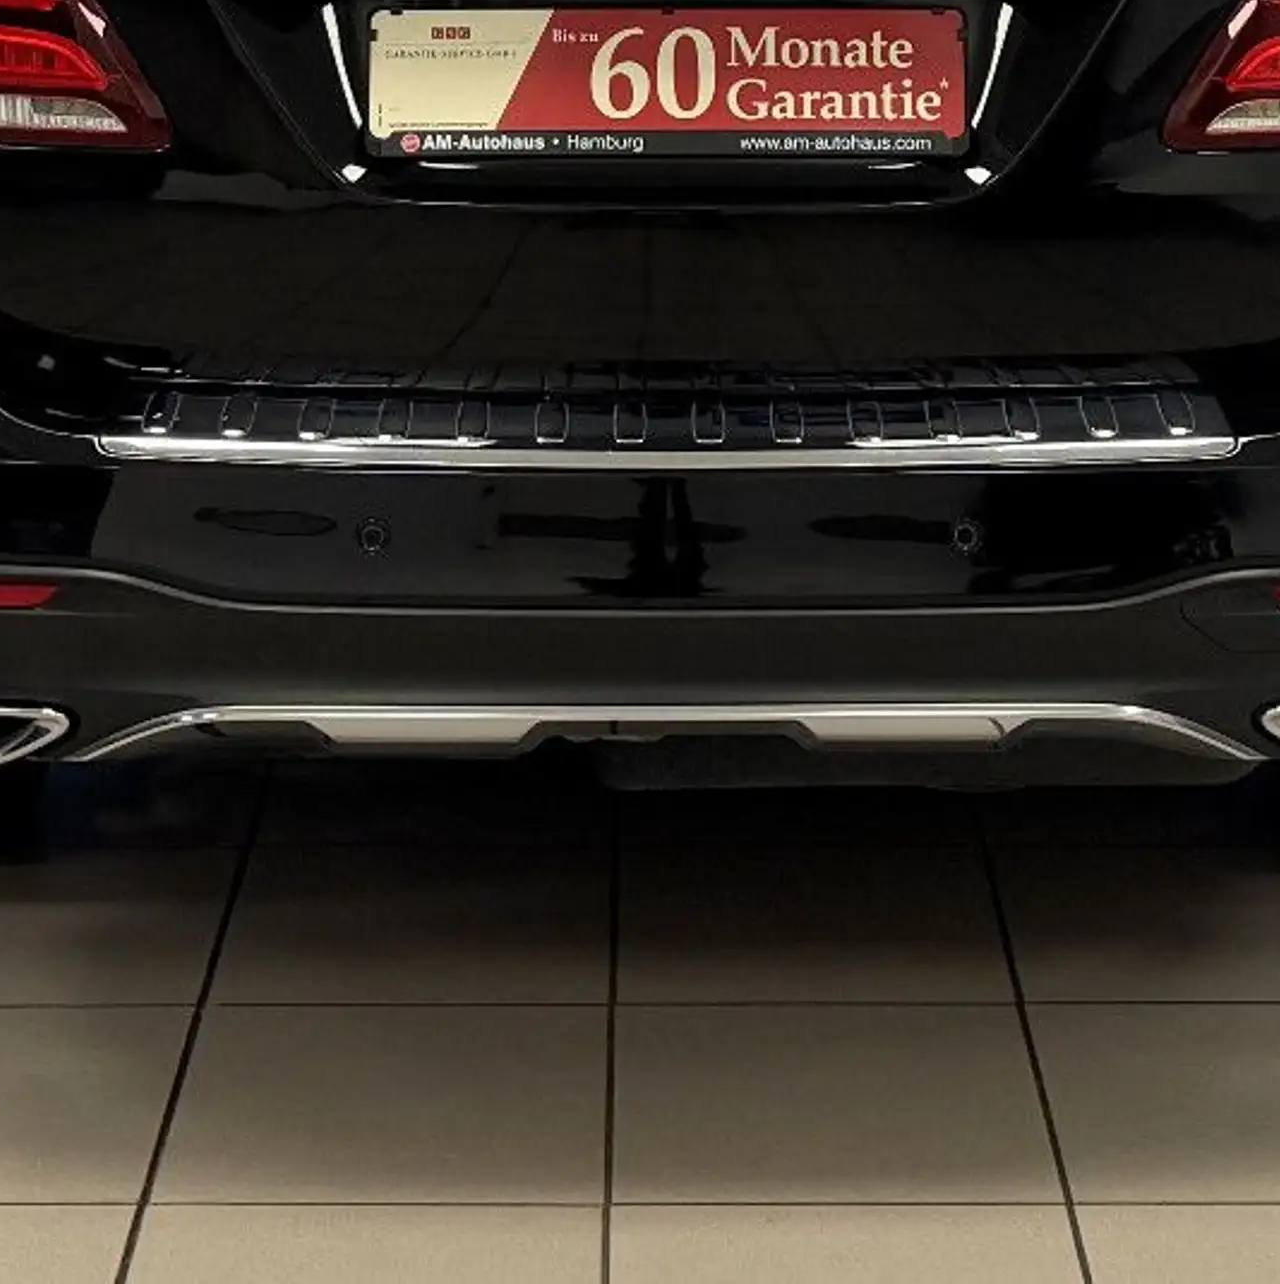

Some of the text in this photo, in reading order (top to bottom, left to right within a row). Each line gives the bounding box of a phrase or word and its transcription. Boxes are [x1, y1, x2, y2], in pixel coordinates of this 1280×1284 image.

[552, 28, 599, 43] Bis zu
[590, 26, 914, 120] 60 Monate
[422, 134, 644, 152] AM-Autohaus Hamburg
[740, 135, 932, 151] www.am-autohaus.com
